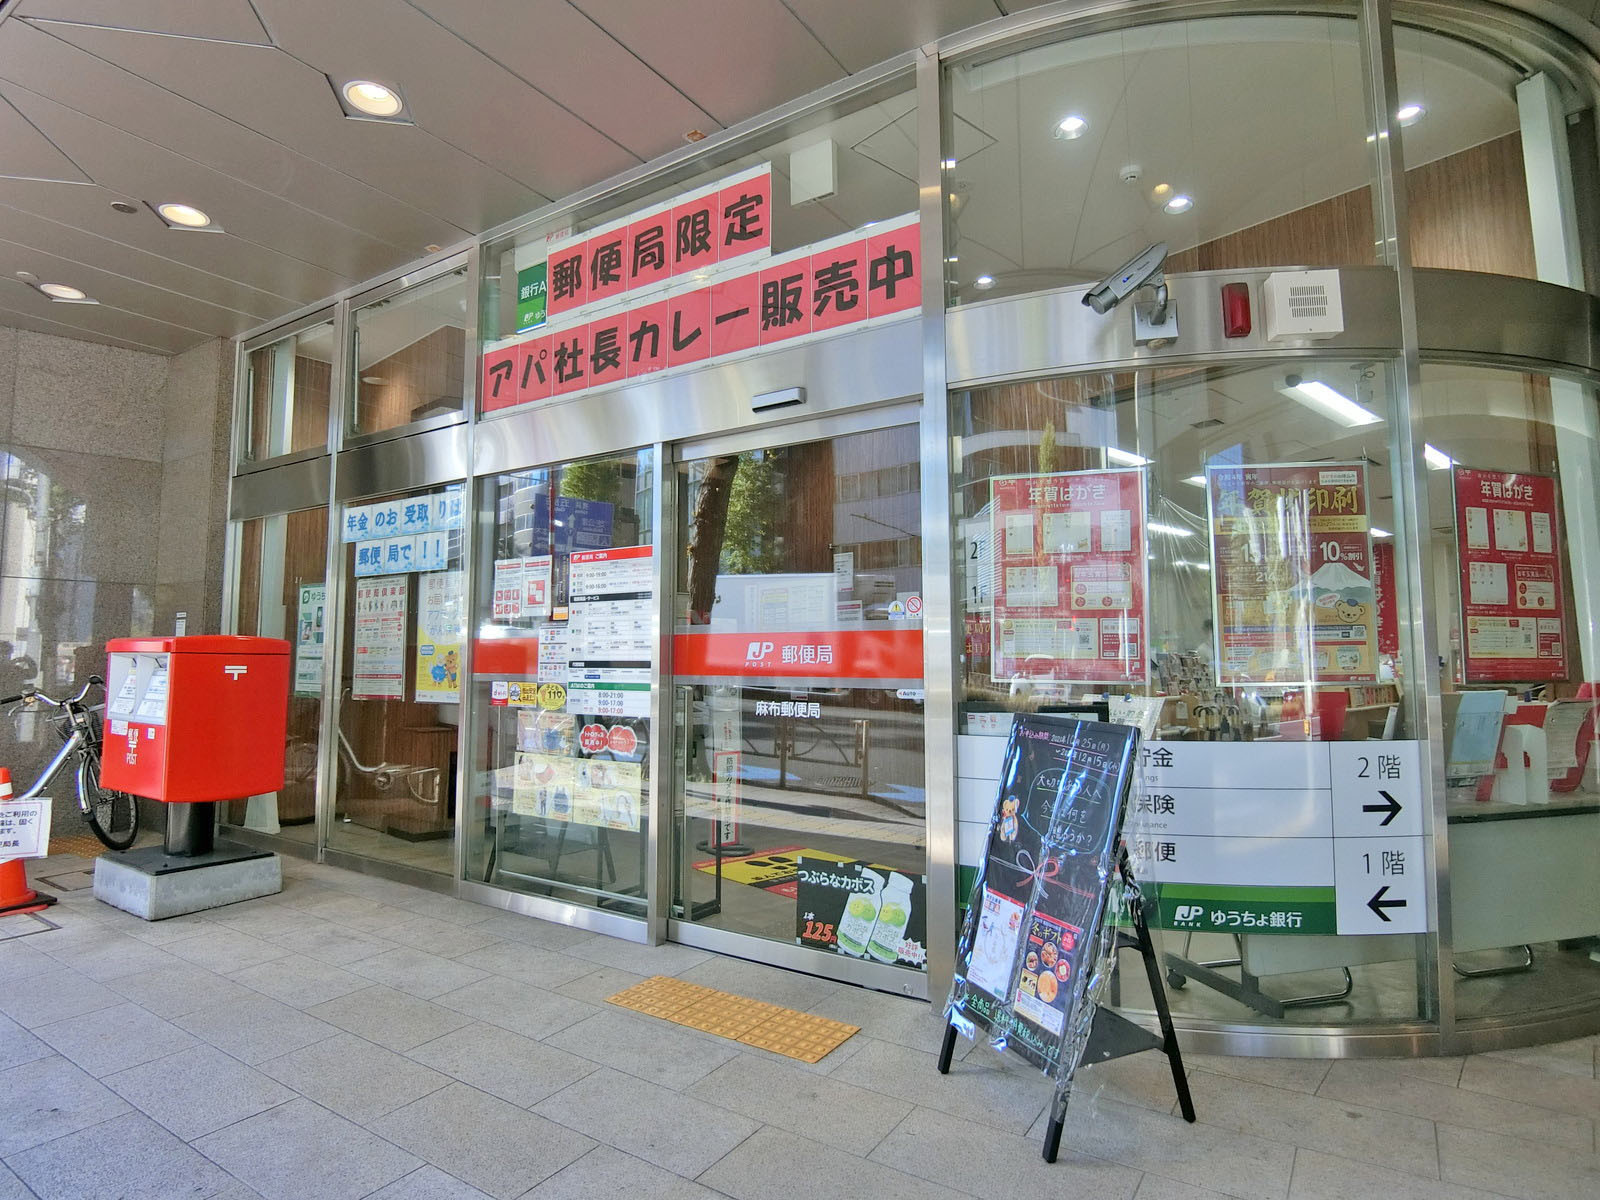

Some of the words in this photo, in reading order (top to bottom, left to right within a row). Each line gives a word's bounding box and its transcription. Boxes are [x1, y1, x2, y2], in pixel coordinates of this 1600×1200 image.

[552, 194, 763, 301] 郵便局限定
[489, 245, 914, 398] アパ社長カレー販売中
[1028, 484, 1105, 502] 年賀はがき
[1480, 480, 1533, 500] 年賀はがき
[746, 642, 774, 660] JP
[781, 645, 833, 664] 郵便局
[755, 701, 821, 719] 麻布郵便局
[1357, 754, 1401, 780] 2階
[1362, 850, 1406, 876] 1階
[798, 869, 876, 894] つぶらなカボス
[1175, 905, 1203, 921] JP
[1210, 910, 1303, 928] ゆうちょ銀行
